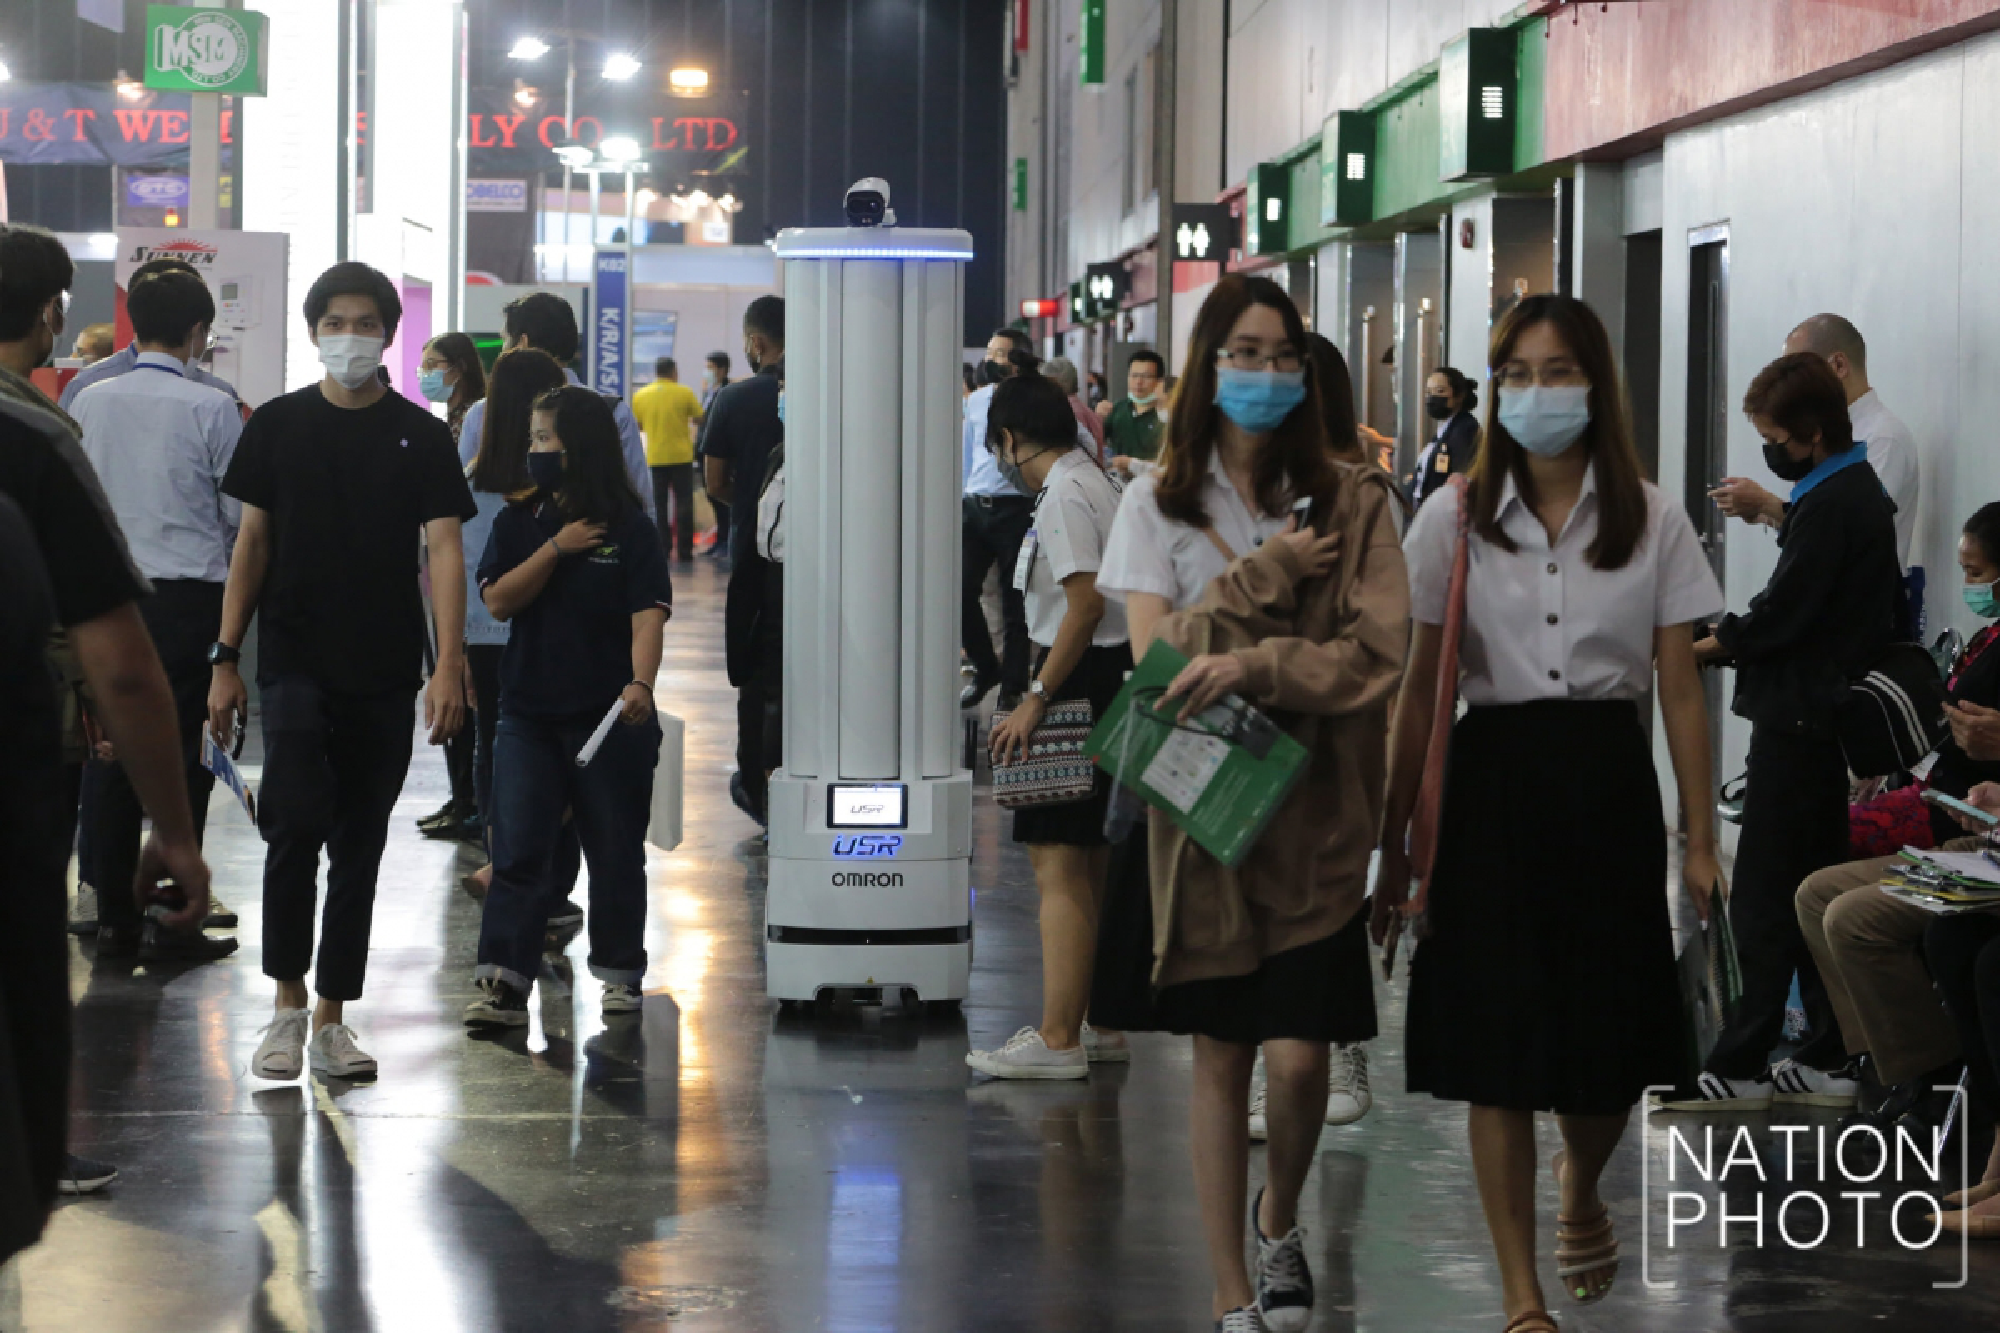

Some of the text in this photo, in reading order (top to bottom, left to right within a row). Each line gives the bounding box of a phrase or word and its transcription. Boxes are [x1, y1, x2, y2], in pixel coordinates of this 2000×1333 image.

[22, 108, 58, 142] &
[63, 108, 98, 142] T
[468, 113, 526, 148] LY
[651, 117, 738, 152] LTD
[467, 182, 525, 199] OBELCO
[831, 872, 904, 887] OMRON
